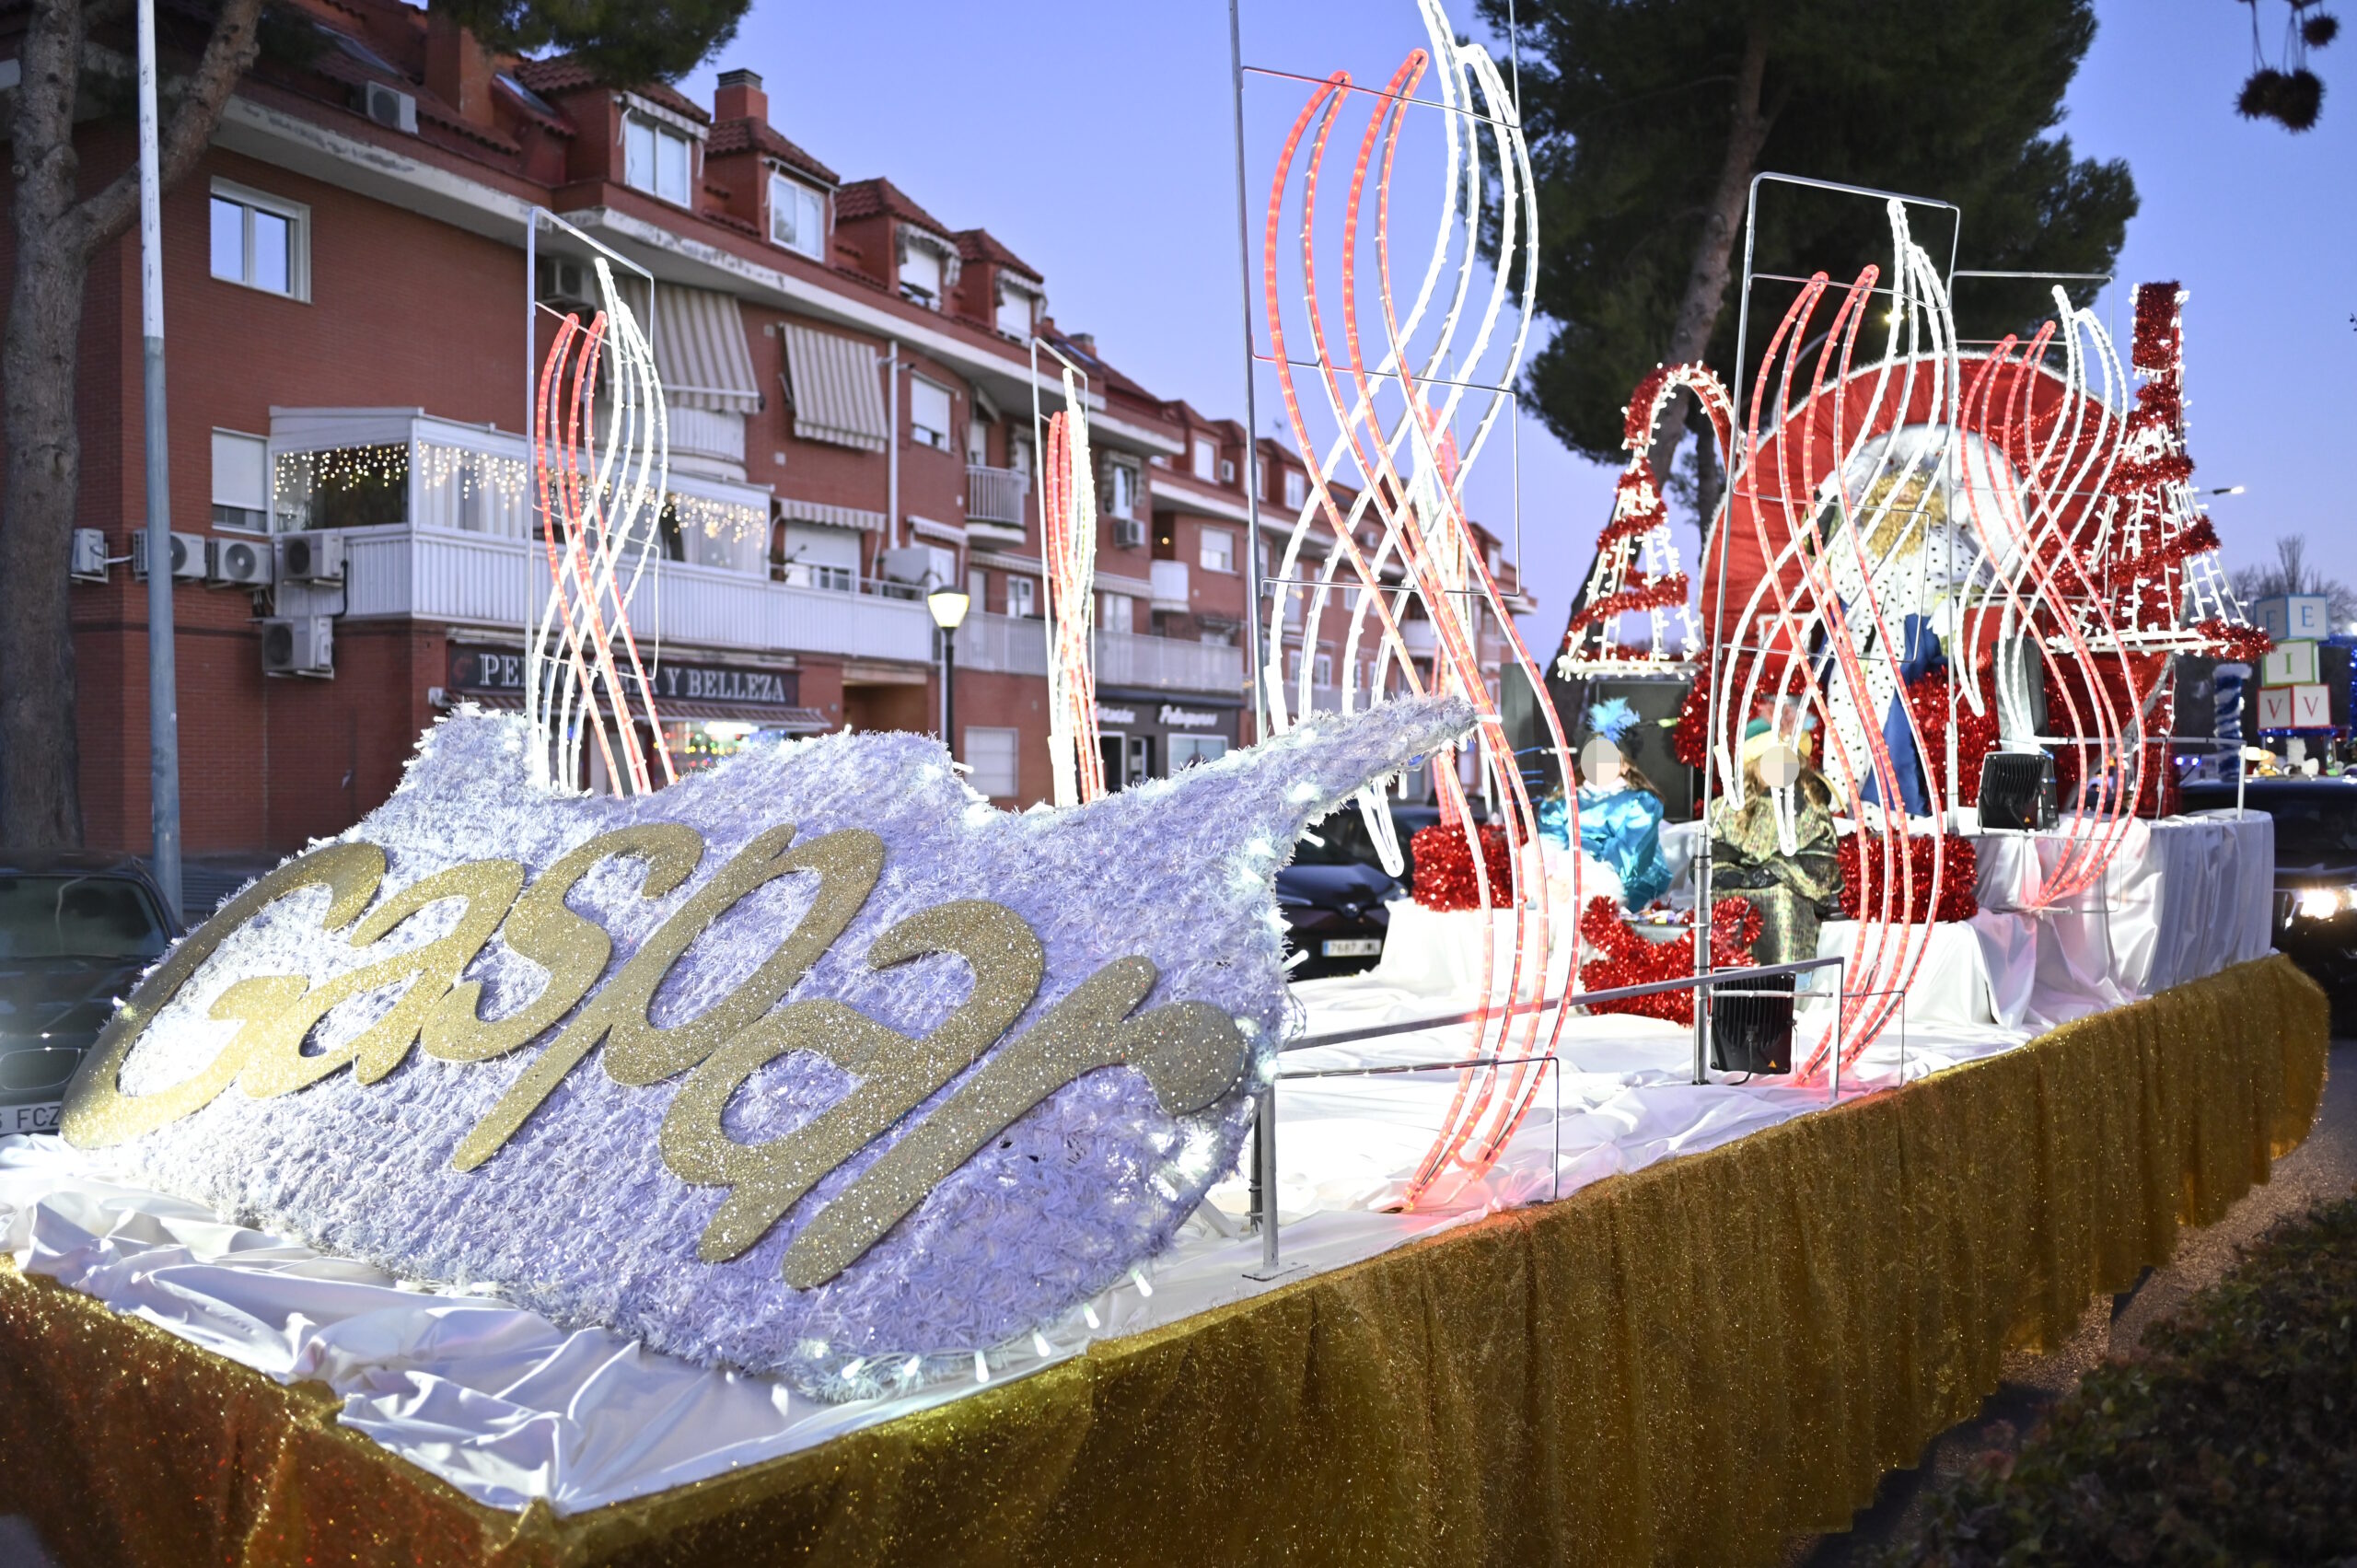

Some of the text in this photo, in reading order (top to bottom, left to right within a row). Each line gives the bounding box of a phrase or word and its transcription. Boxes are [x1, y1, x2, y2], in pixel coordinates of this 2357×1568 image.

[2302, 605, 2315, 627] E
[2284, 653, 2293, 674] I
[664, 667, 682, 696] Y
[687, 668, 786, 703] BELLEZA
[2268, 698, 2282, 720] V
[2304, 696, 2318, 717] V
[61, 821, 1246, 1289] Gaspar
[17, 1106, 61, 1129] FCZ
